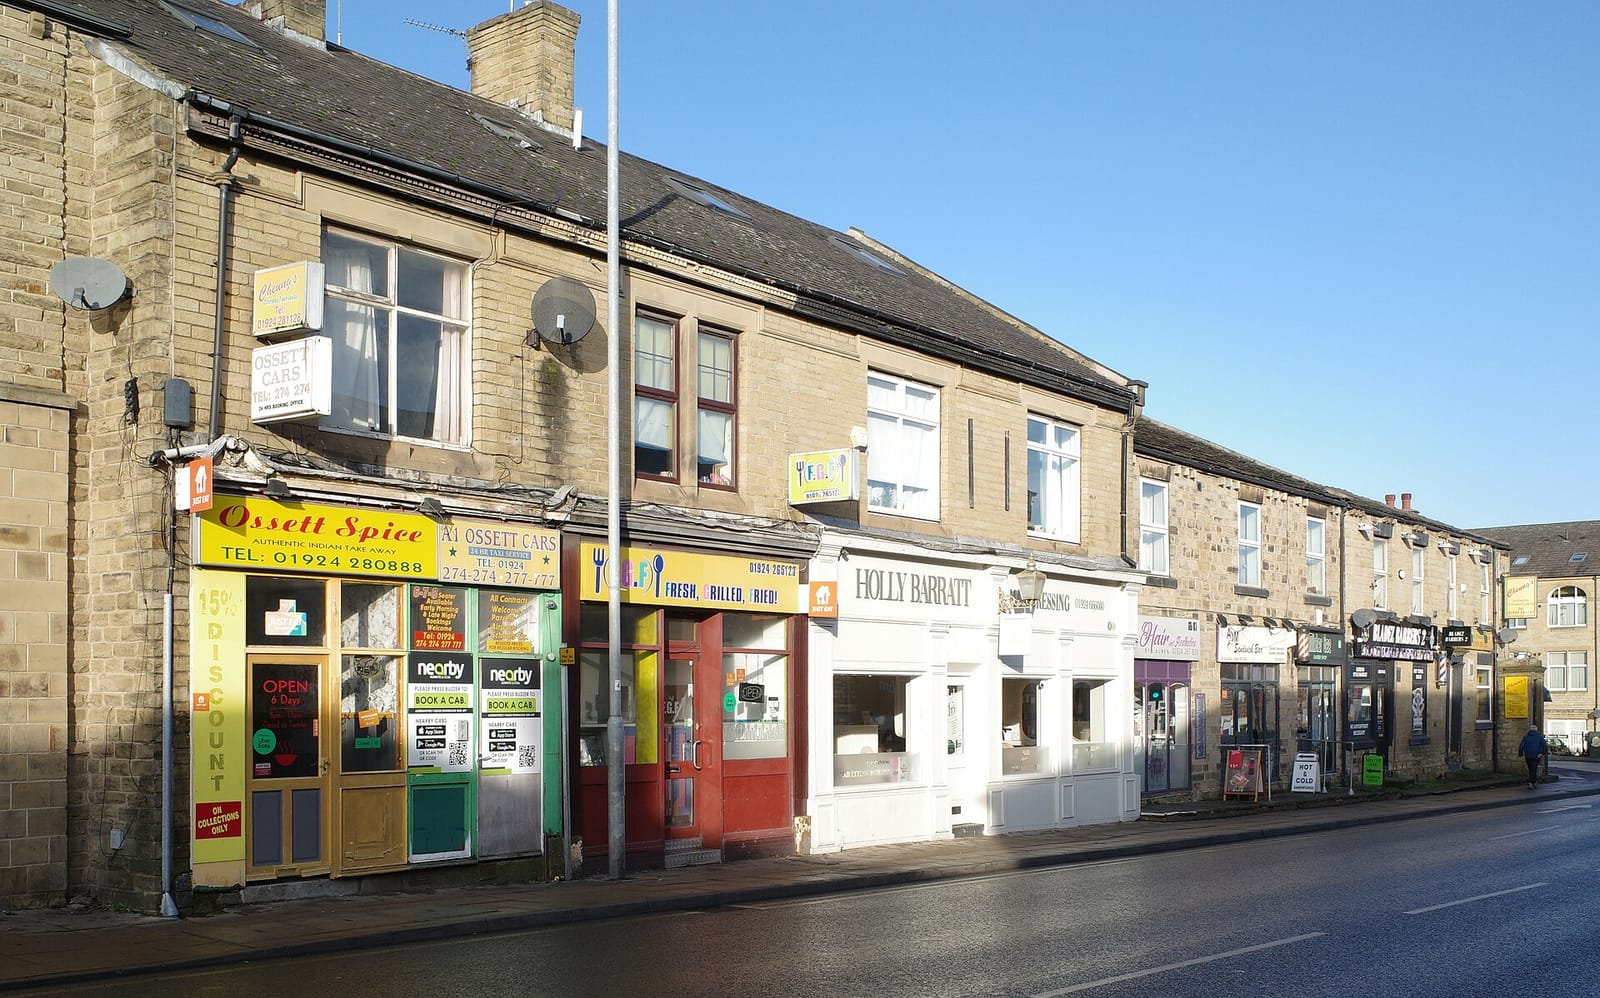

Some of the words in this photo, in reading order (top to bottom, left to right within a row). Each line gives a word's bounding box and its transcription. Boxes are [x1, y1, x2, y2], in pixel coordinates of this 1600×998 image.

[257, 318, 276, 329] 01924
[255, 347, 309, 370] OSSETT
[262, 366, 300, 386] CARS
[253, 390, 271, 403] TEL:
[274, 386, 289, 399] 274
[294, 383, 310, 396] 274
[290, 399, 304, 407] OFFICE
[219, 505, 326, 534] Ossett
[335, 516, 422, 543] Spice
[252, 538, 305, 548] AUTHENTIC
[369, 547, 397, 555] AWAY
[441, 526, 459, 542] A1
[465, 528, 518, 548] OSSETT
[522, 533, 556, 552] CARS
[221, 546, 264, 562] TEL:
[274, 552, 340, 567] 01924
[349, 557, 422, 573] 280888
[490, 549, 504, 557] TAXI
[505, 551, 529, 559] SERVICE
[477, 558, 496, 568] TEL:
[498, 560, 524, 570] 01924
[749, 562, 770, 574] 01924
[443, 567, 496, 582] 274-274
[665, 582, 699, 601] FRESH,
[704, 585, 745, 604] GRILLED,
[749, 588, 778, 604] FRIED!
[856, 568, 907, 602] HOLLY
[910, 573, 972, 607] BARRATT
[426, 598, 453, 606] Available
[438, 592, 456, 600] Seater
[490, 594, 499, 602] All
[420, 604, 435, 612] Early
[426, 618, 451, 626] Bookings
[427, 624, 452, 632] Welcome
[1140, 621, 1169, 653] Hair
[1395, 626, 1421, 645] BARBERS
[1421, 628, 1427, 646] 2
[418, 660, 464, 679] nearby
[490, 666, 532, 685] nearby
[263, 680, 309, 693] OPEN
[208, 622, 224, 791] DISCOUNT
[271, 695, 277, 704] 6
[281, 694, 301, 705] Days
[212, 806, 222, 815] ON
[197, 811, 239, 828] COLLECTIONS
[212, 823, 228, 835] ONLY
